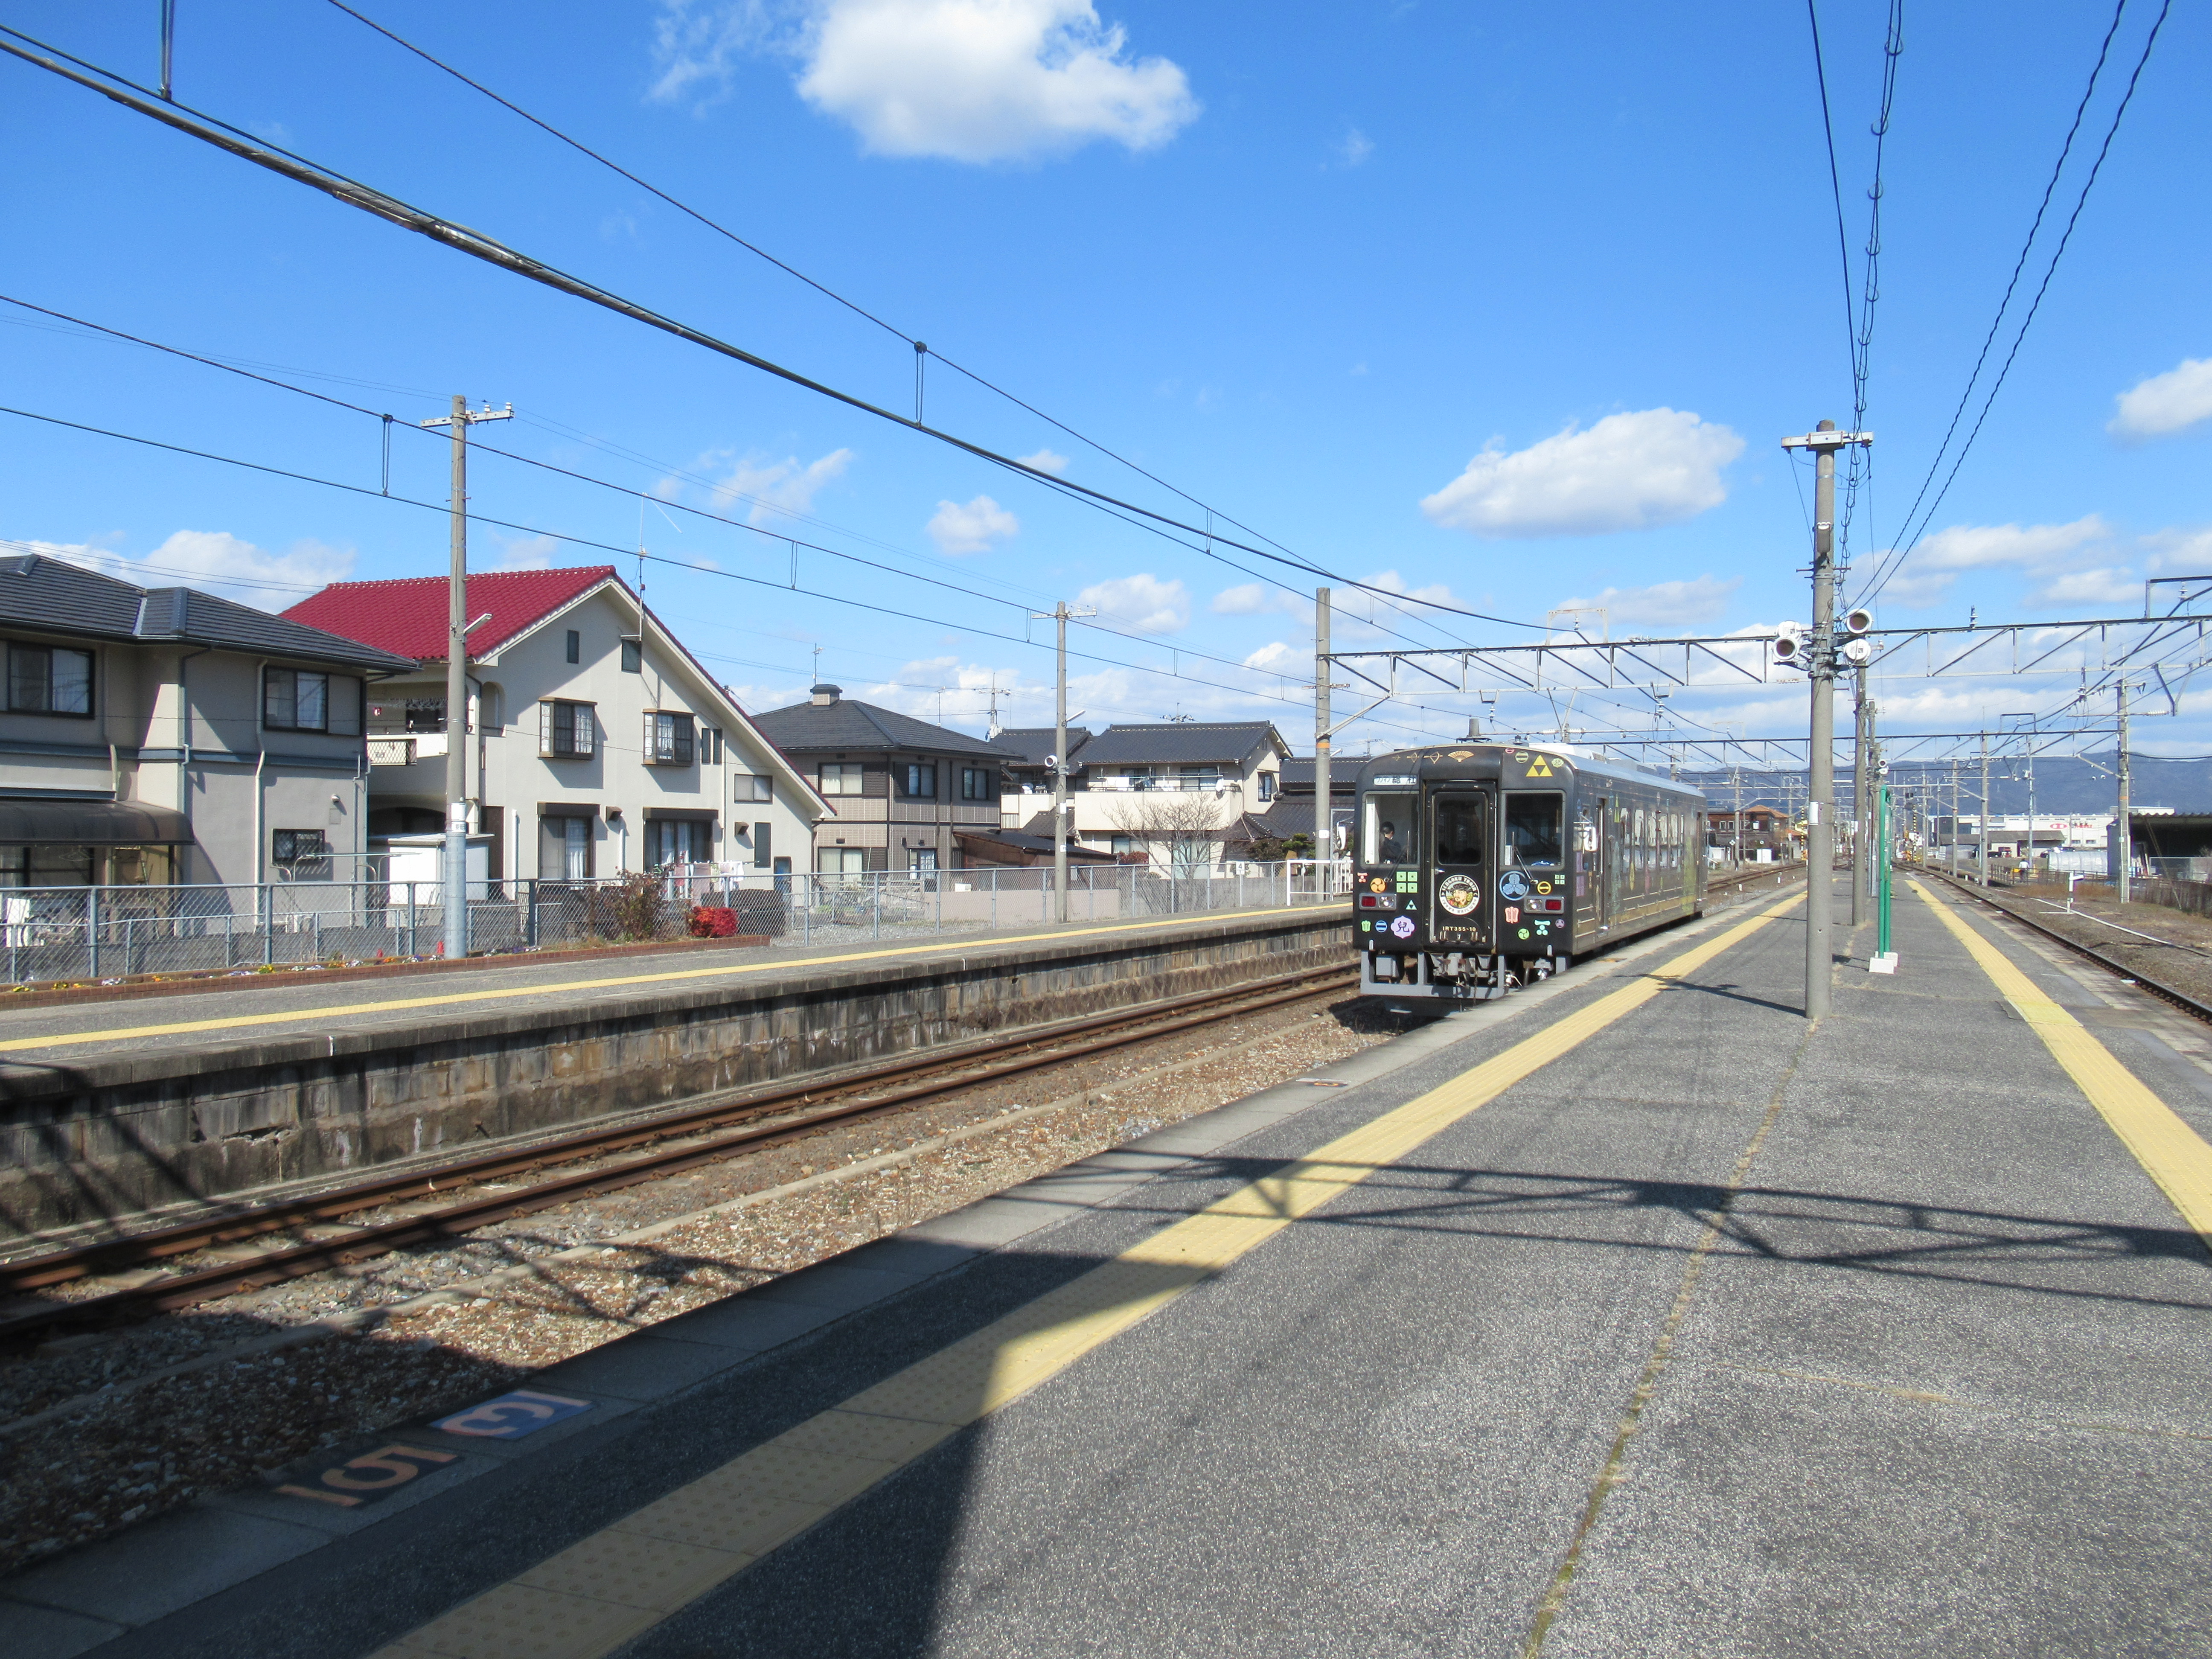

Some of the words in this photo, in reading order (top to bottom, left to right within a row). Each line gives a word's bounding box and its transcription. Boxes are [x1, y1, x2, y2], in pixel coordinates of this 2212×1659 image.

[1392, 775, 1416, 784] 総社
[1442, 876, 1462, 891] SENGOKU
[1464, 877, 1477, 891] TRAIN
